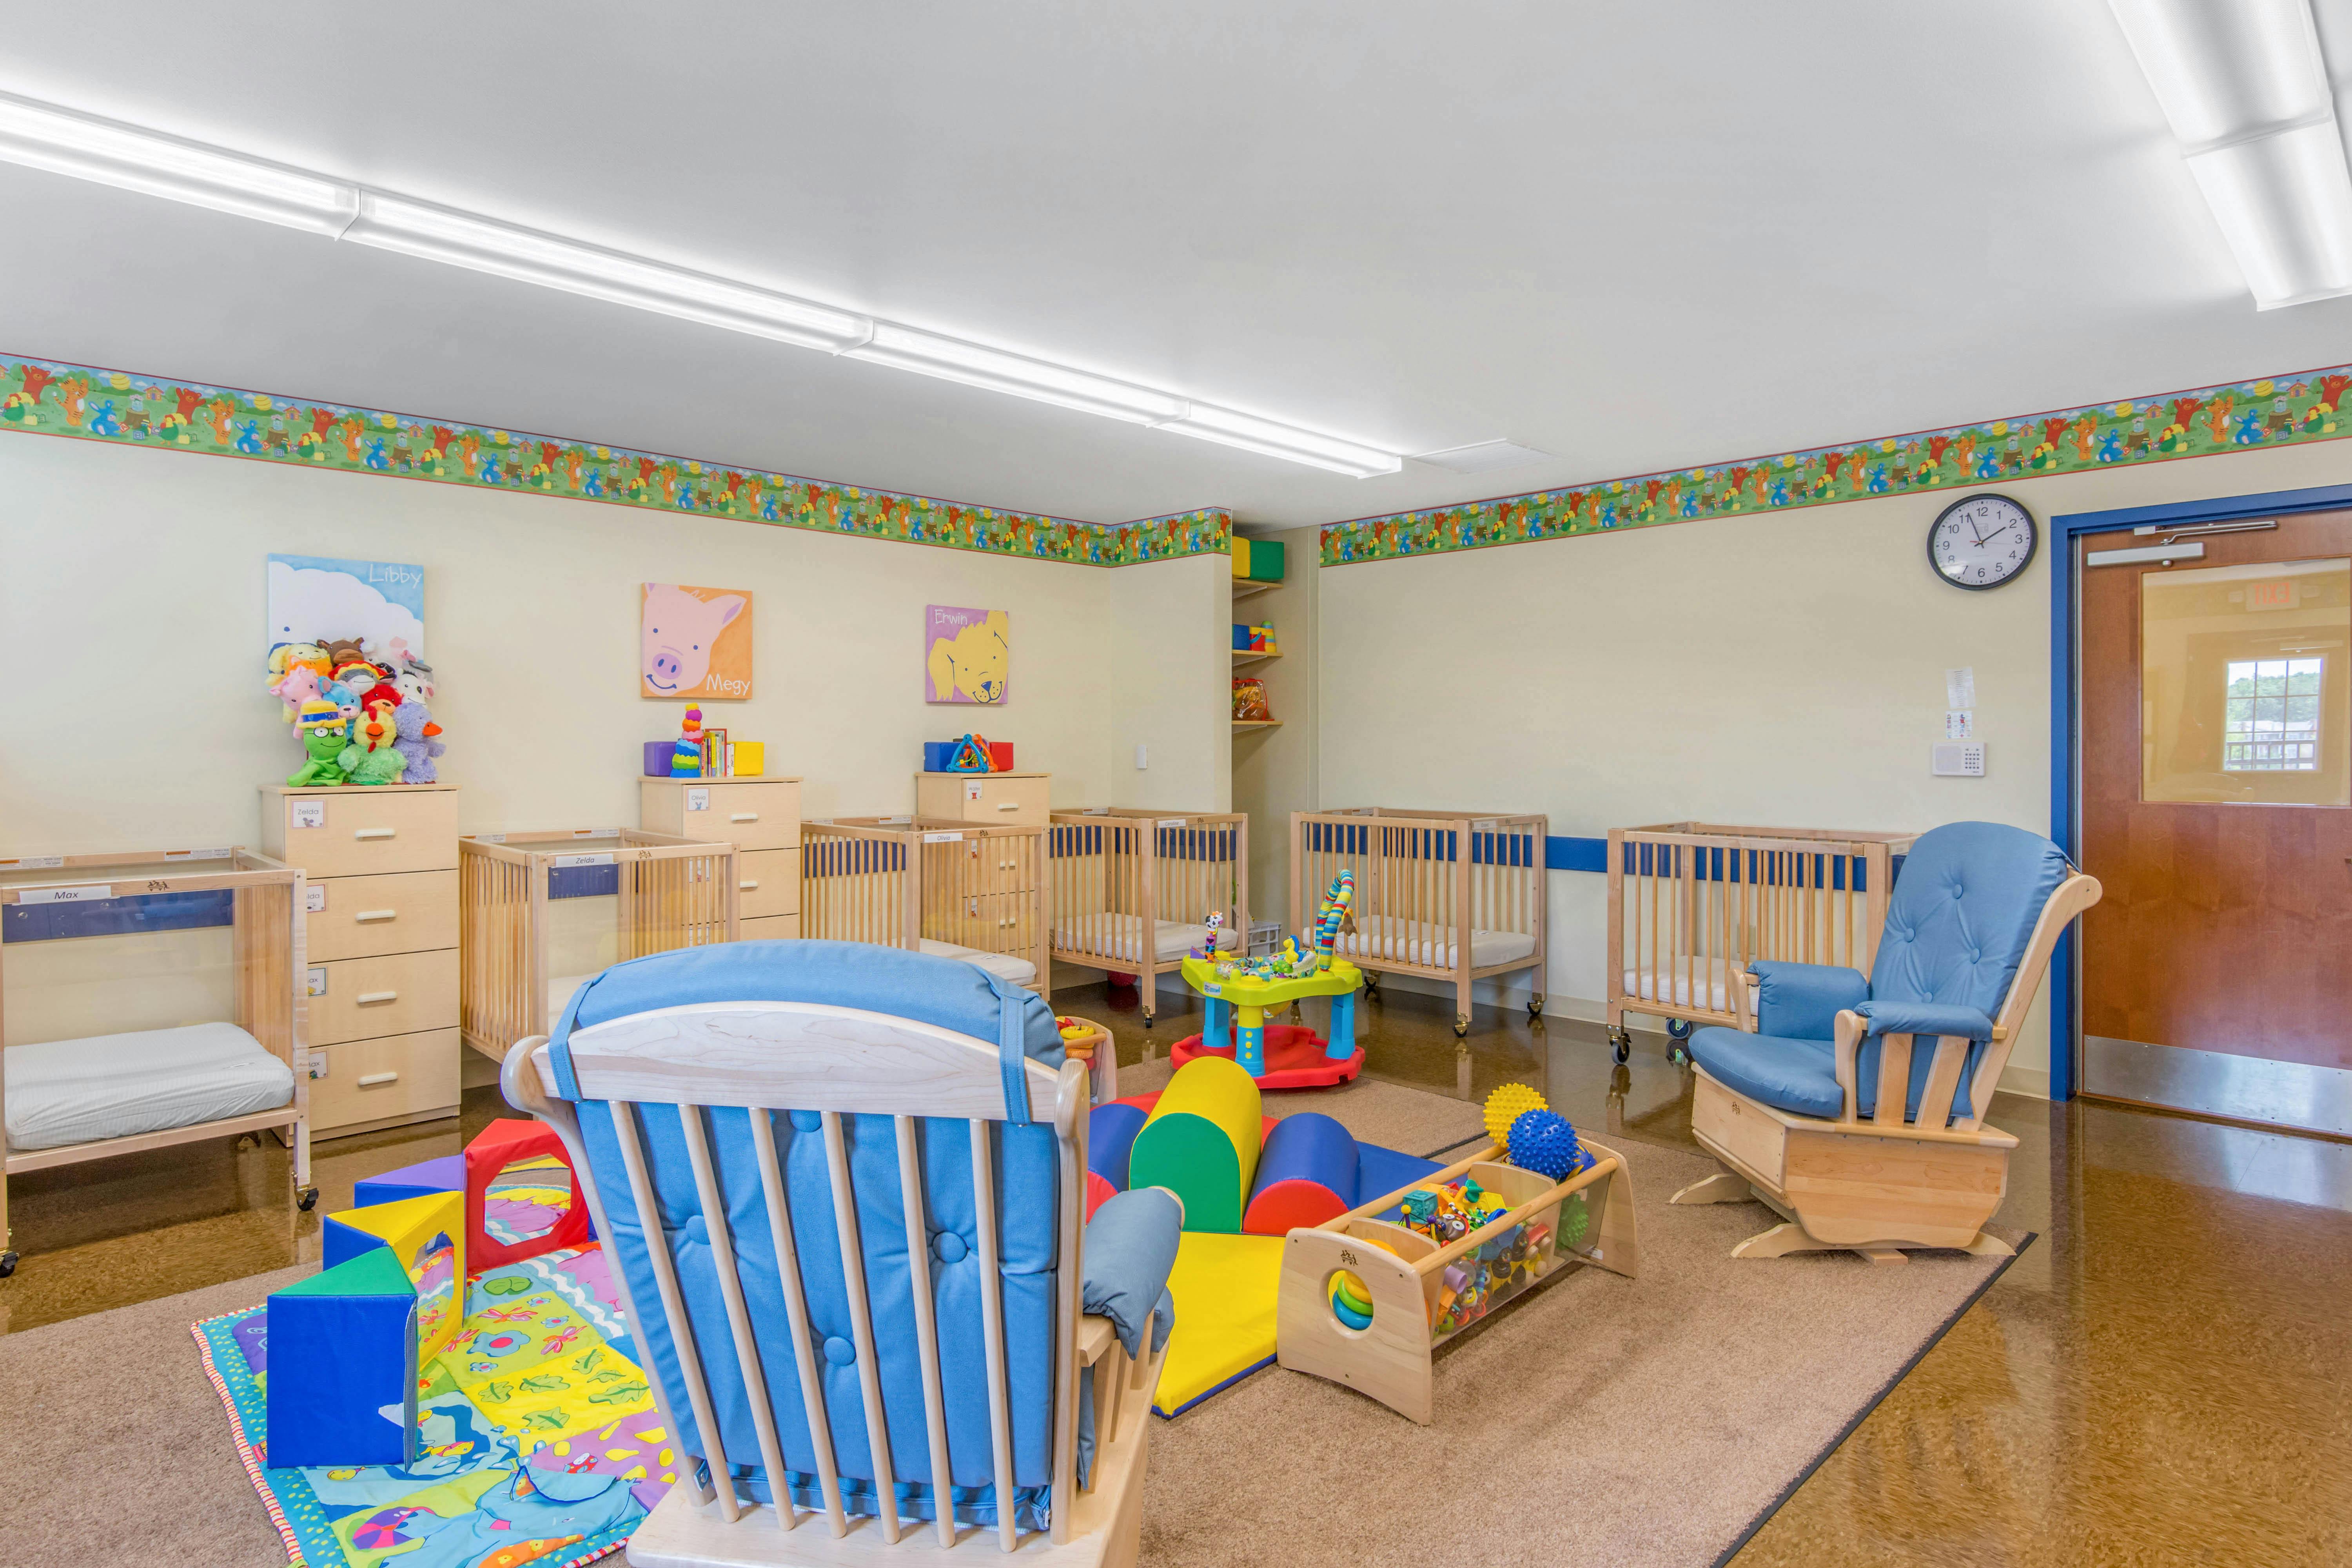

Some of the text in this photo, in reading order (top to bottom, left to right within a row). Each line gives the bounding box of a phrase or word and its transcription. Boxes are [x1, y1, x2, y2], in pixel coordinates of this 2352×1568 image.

[1976, 507, 1988, 517] 12
[1997, 510, 2002, 519] 1
[1959, 514, 1970, 523] 11
[2009, 519, 2017, 528] 2
[1948, 524, 1959, 534] 10
[2015, 534, 2023, 544] 3
[1943, 541, 1950, 550] 9
[1948, 555, 1955, 564] 8
[2009, 550, 2017, 560] 4
[1995, 563, 2003, 572] 5
[368, 562, 423, 589] Libby
[1978, 568, 1985, 577] 6
[934, 608, 968, 626] Erwin
[706, 673, 751, 696] Megy
[54, 891, 79, 900] Max
